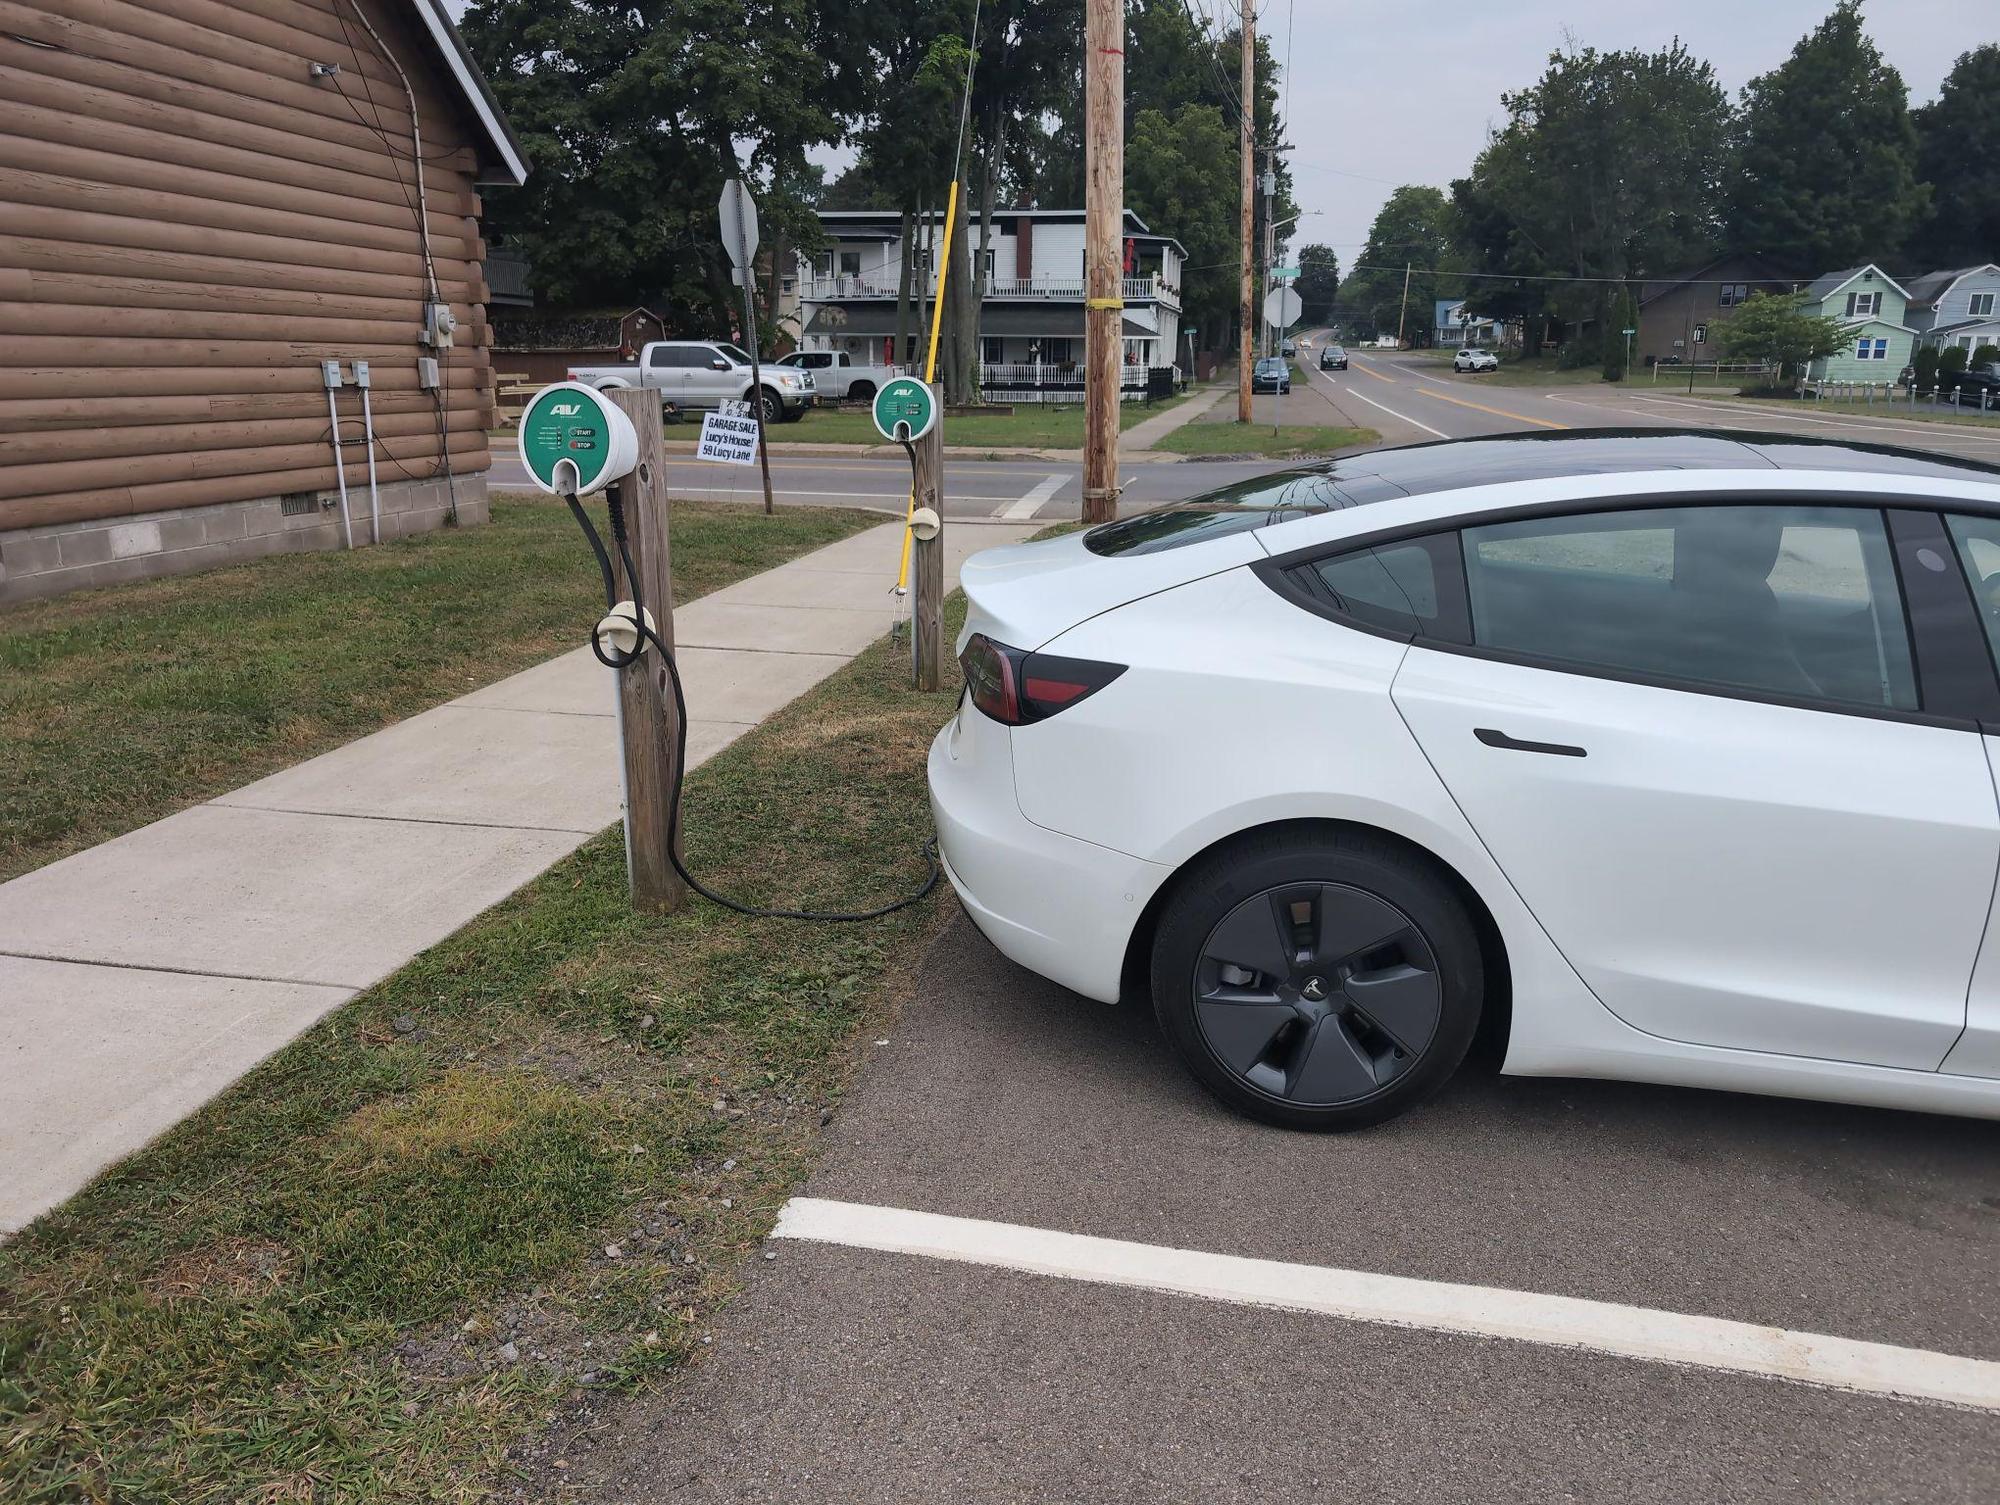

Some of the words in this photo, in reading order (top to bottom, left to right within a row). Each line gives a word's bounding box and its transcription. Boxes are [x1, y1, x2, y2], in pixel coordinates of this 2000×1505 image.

[709, 418, 738, 431] GARAGE
[738, 421, 757, 434] SALE
[705, 431, 728, 445] Lucy's
[728, 434, 754, 448] House!
[703, 445, 712, 455] 59
[713, 446, 732, 460] Lucy
[732, 449, 750, 461] Lane
